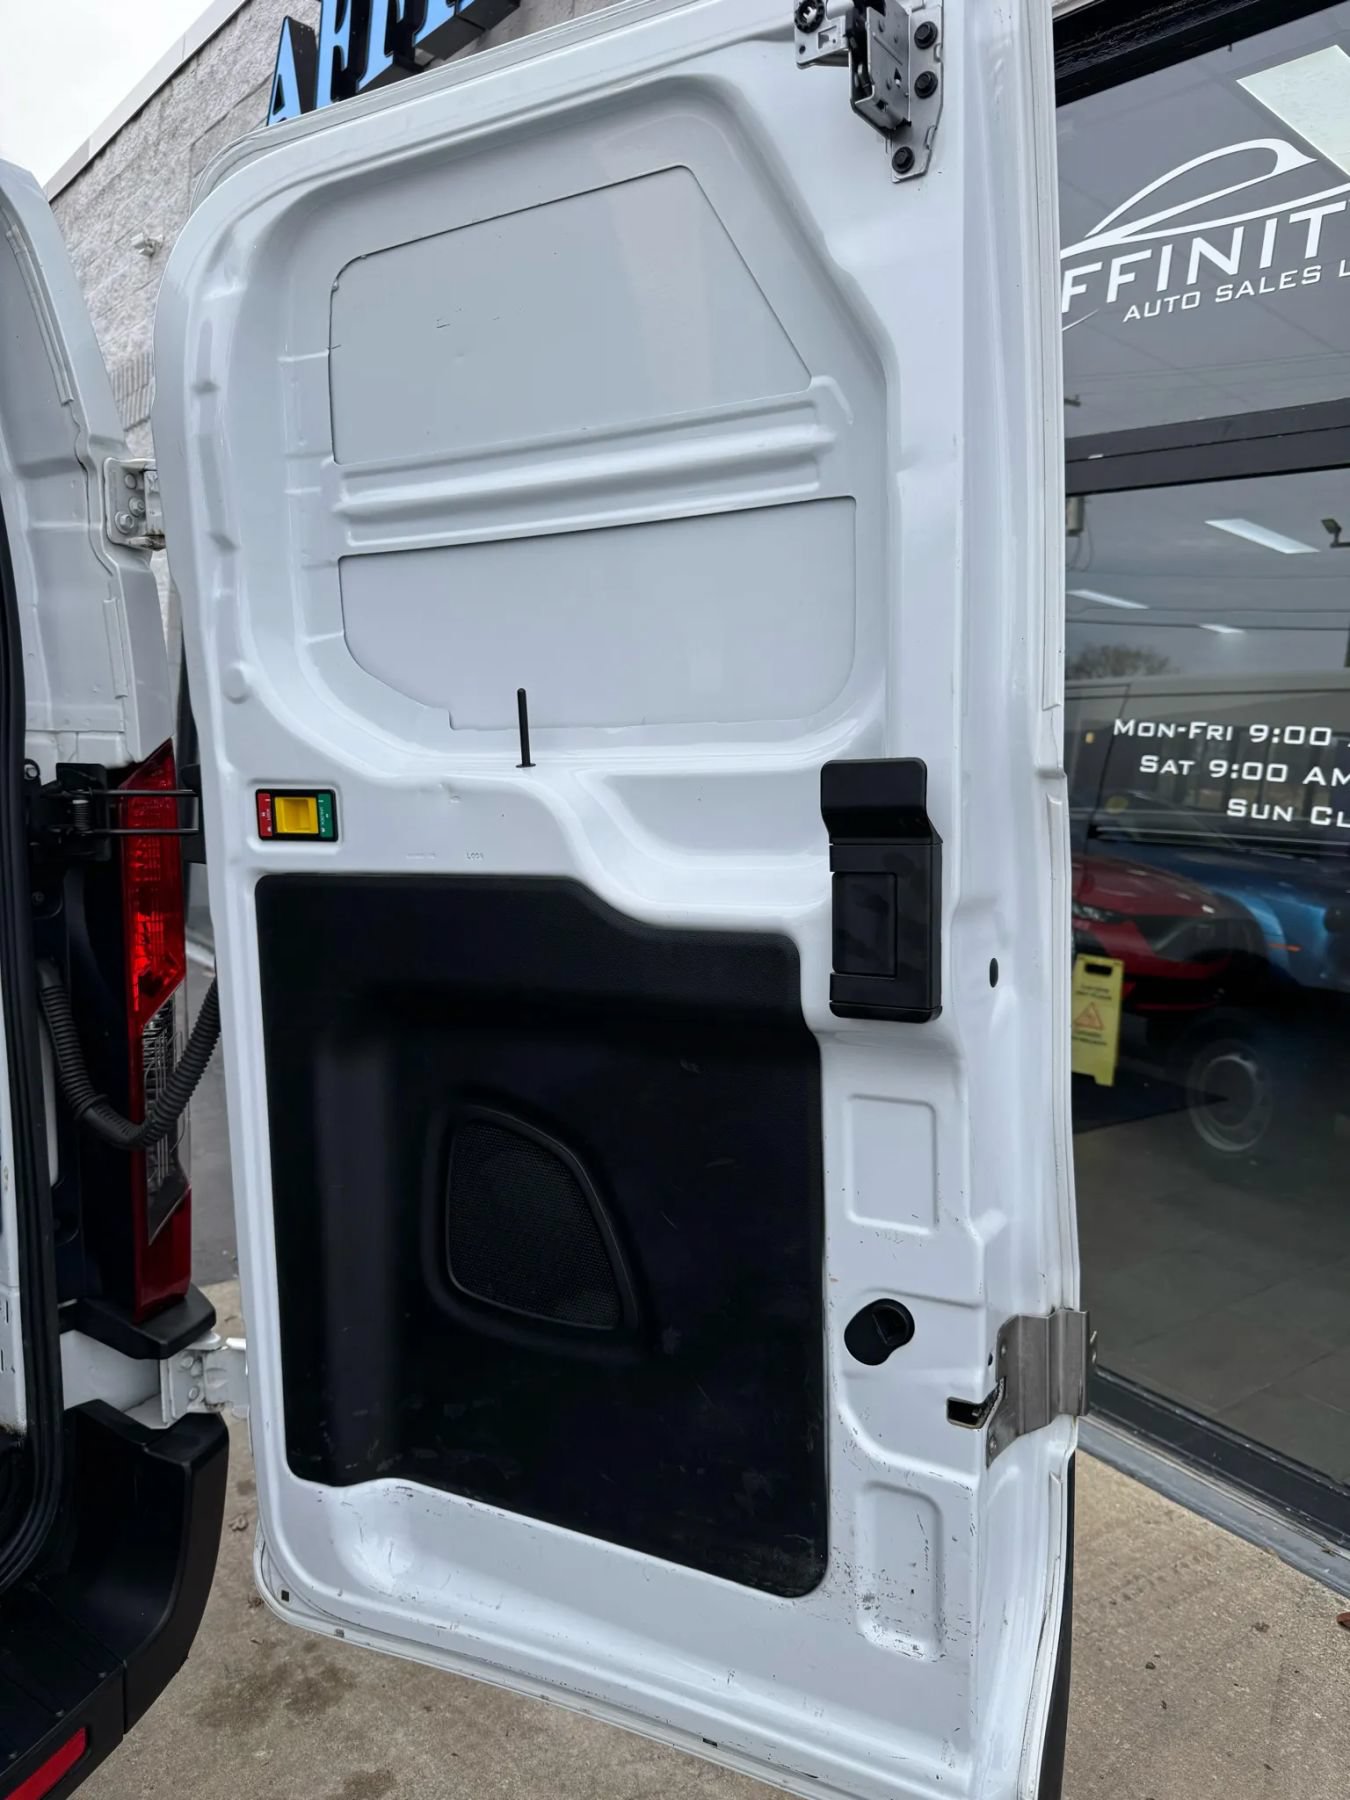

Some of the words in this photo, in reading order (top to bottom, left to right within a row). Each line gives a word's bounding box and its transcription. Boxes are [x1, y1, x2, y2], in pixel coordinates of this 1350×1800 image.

[1061, 200, 1350, 314] FFINIT
[1122, 291, 1201, 323] AUTO
[1214, 265, 1322, 304] SALES
[1249, 723, 1332, 747] 9:00
[1208, 759, 1289, 783] 9:00
